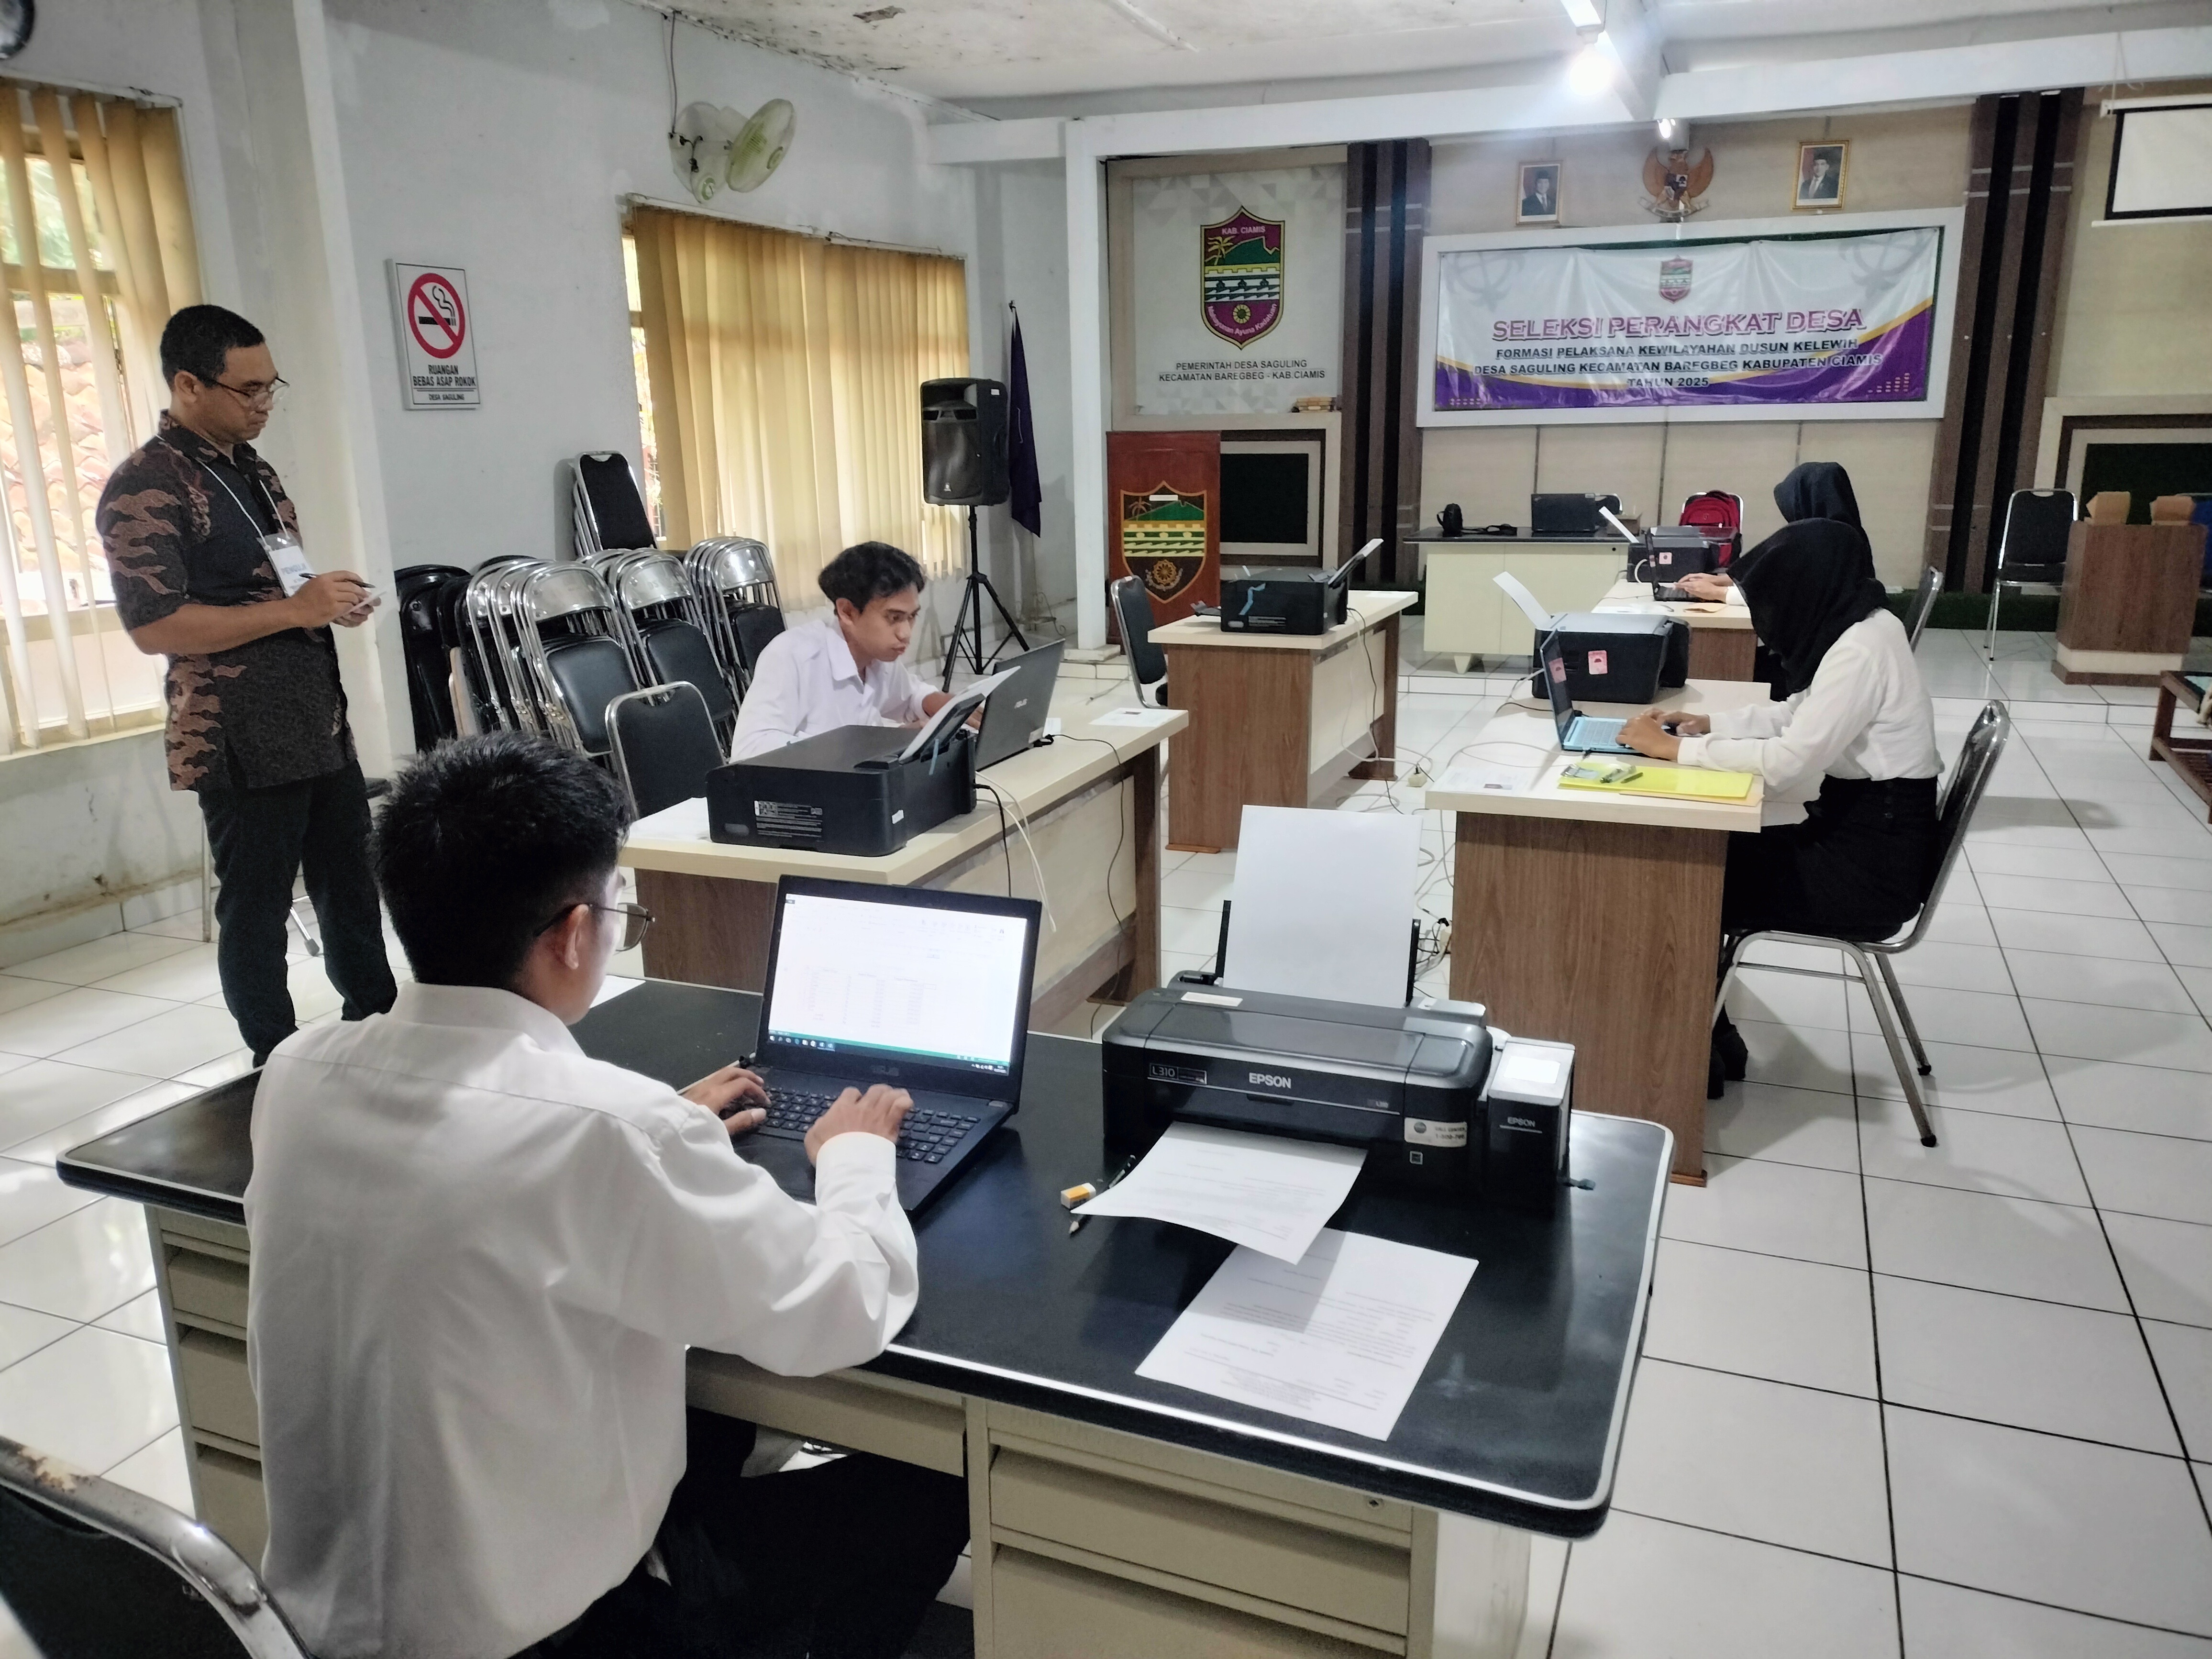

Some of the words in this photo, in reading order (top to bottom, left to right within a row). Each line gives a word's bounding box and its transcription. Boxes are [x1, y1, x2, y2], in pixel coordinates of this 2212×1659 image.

[1240, 226, 1266, 234] CIAMIS
[1493, 318, 1603, 341] SELEKSI
[1607, 312, 1782, 338] PERANGKAT
[1785, 309, 1867, 333] DESA
[1495, 348, 1553, 360] FORMASI
[1556, 346, 1634, 358] PELAKSANA
[1638, 343, 1736, 356] KEWILAYAHAN
[1739, 343, 1789, 354] DUSUN
[1793, 339, 1858, 353] KELEWIH
[428, 365, 459, 375] RUANGAN
[1176, 362, 1232, 370] PEMERINTAH
[1261, 360, 1307, 368] SAGULING
[1473, 365, 1506, 376] DESA
[1509, 363, 1576, 375] SAGULING
[1579, 362, 1660, 374] KECAMATAN
[1663, 361, 1738, 373] BAREGBEG
[1741, 357, 1826, 371] KABUPATEN
[1830, 354, 1883, 367] CIAMIS
[413, 376, 434, 386] BEBAS
[436, 376, 453, 386] ASAP
[454, 376, 476, 386] ROKOK
[1159, 373, 1212, 381] KECAMATAN
[1215, 372, 1264, 380] BAREGBEG
[1627, 377, 1673, 388] TAHUN
[1677, 377, 1709, 387] 2025
[1151, 1065, 1175, 1077] L310
[1249, 1072, 1292, 1089] EPSON
[1507, 1117, 1536, 1128] EPSON
